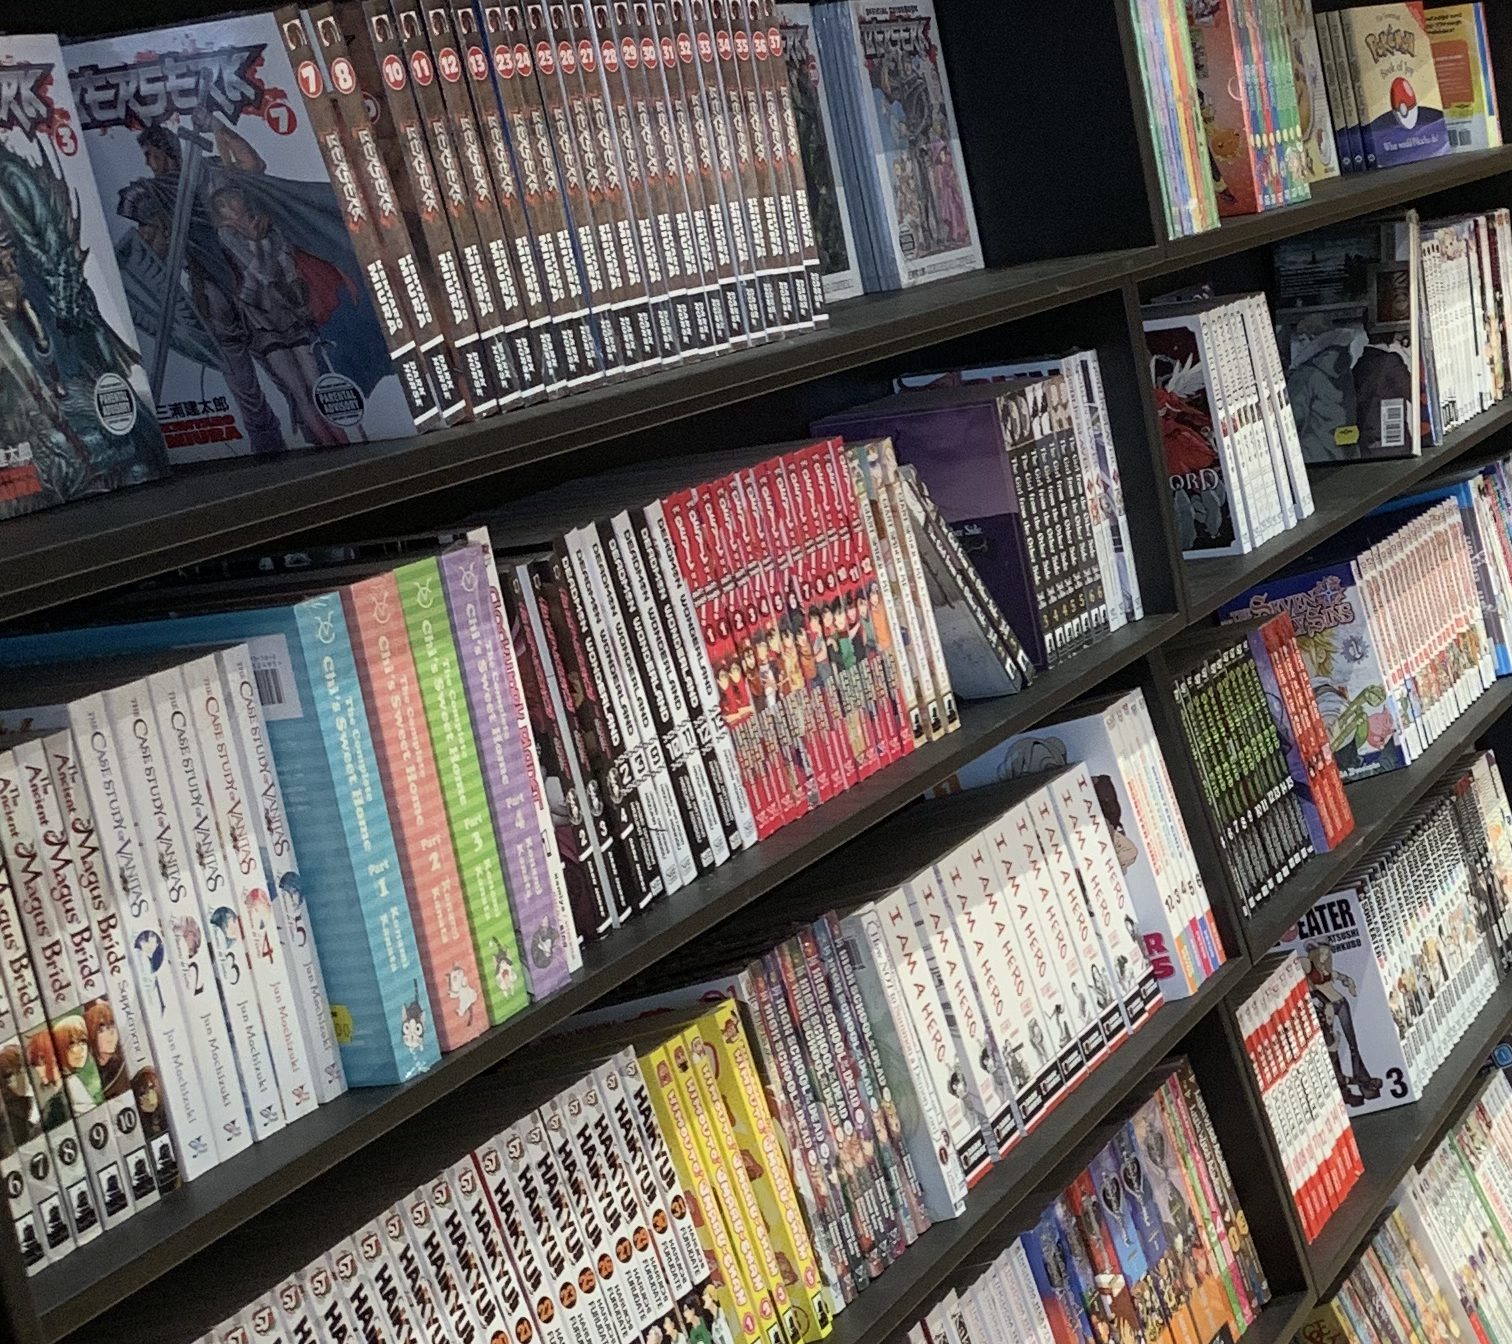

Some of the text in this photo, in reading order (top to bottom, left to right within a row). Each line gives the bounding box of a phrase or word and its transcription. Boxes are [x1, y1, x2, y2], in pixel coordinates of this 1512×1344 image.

[68, 44, 269, 131] ERSERK
[305, 68, 319, 93] 7
[336, 64, 351, 89] 8
[385, 61, 403, 84] 10
[270, 106, 292, 133] 7
[368, 264, 398, 336] MIURA
[373, 259, 403, 329] KENTARO
[317, 383, 359, 403] PARENTAL
[402, 364, 424, 407] HORSE
[407, 361, 426, 397] DARK
[155, 393, 230, 420] 三浦建太郎
[1015, 476, 1023, 495] Girl
[1019, 497, 1027, 519] from
[1023, 521, 1031, 536] the
[1027, 537, 1036, 563] Other
[1248, 590, 1316, 615] SEVEN
[1305, 601, 1357, 634] SINS
[585, 636, 621, 747] WONDERLAND
[619, 764, 633, 785] 2
[322, 655, 372, 853] Chi's Sweet Home
[204, 695, 274, 965] CASE STUDY VANITAS 4
[54, 753, 121, 977] Ancient Magus Bride
[368, 860, 389, 876] Part
[376, 876, 389, 899] 1
[1298, 898, 1357, 940] EATER
[888, 909, 947, 1065] I AM A HERO
[270, 981, 300, 1074] Jun Mochizuki
[822, 997, 844, 1060] SCHOOL
[842, 1070, 861, 1108] DEAD
[1385, 1067, 1409, 1100] 3
[118, 1107, 136, 1135] 10
[680, 1227, 701, 1278] FURUDATE
[687, 1225, 705, 1270] HARUICHI
